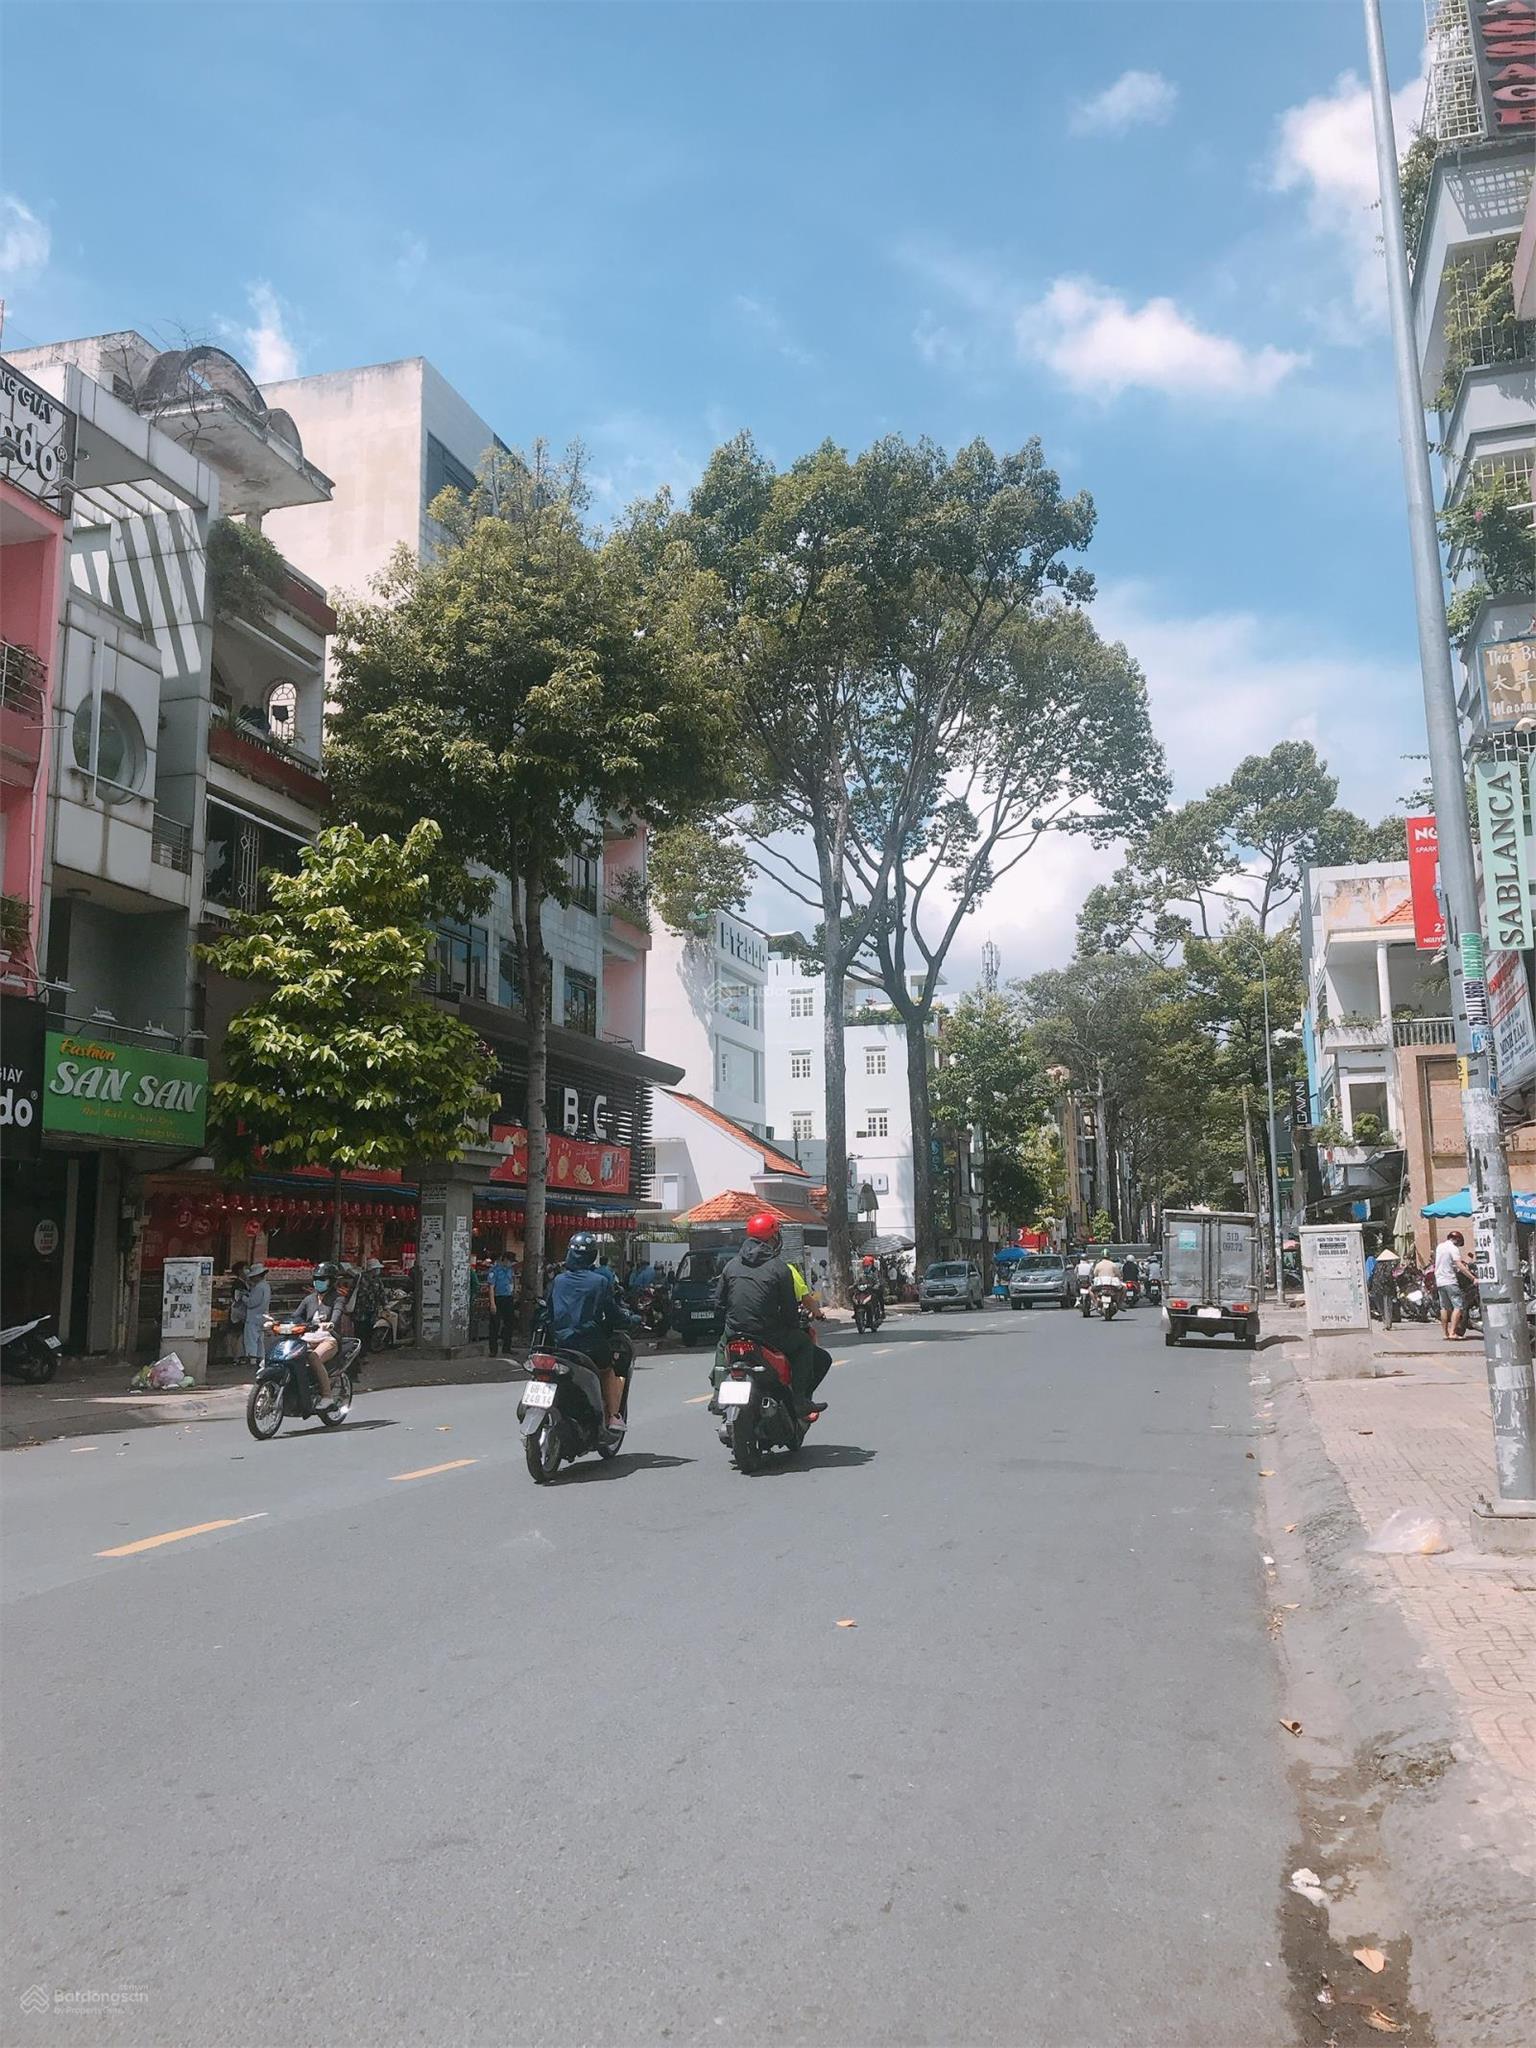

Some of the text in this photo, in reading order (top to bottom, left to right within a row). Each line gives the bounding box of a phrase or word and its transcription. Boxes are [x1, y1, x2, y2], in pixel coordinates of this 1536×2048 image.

[1487, 772, 1526, 948] SABLANCA
[48, 1061, 204, 1114] SAN SAN
